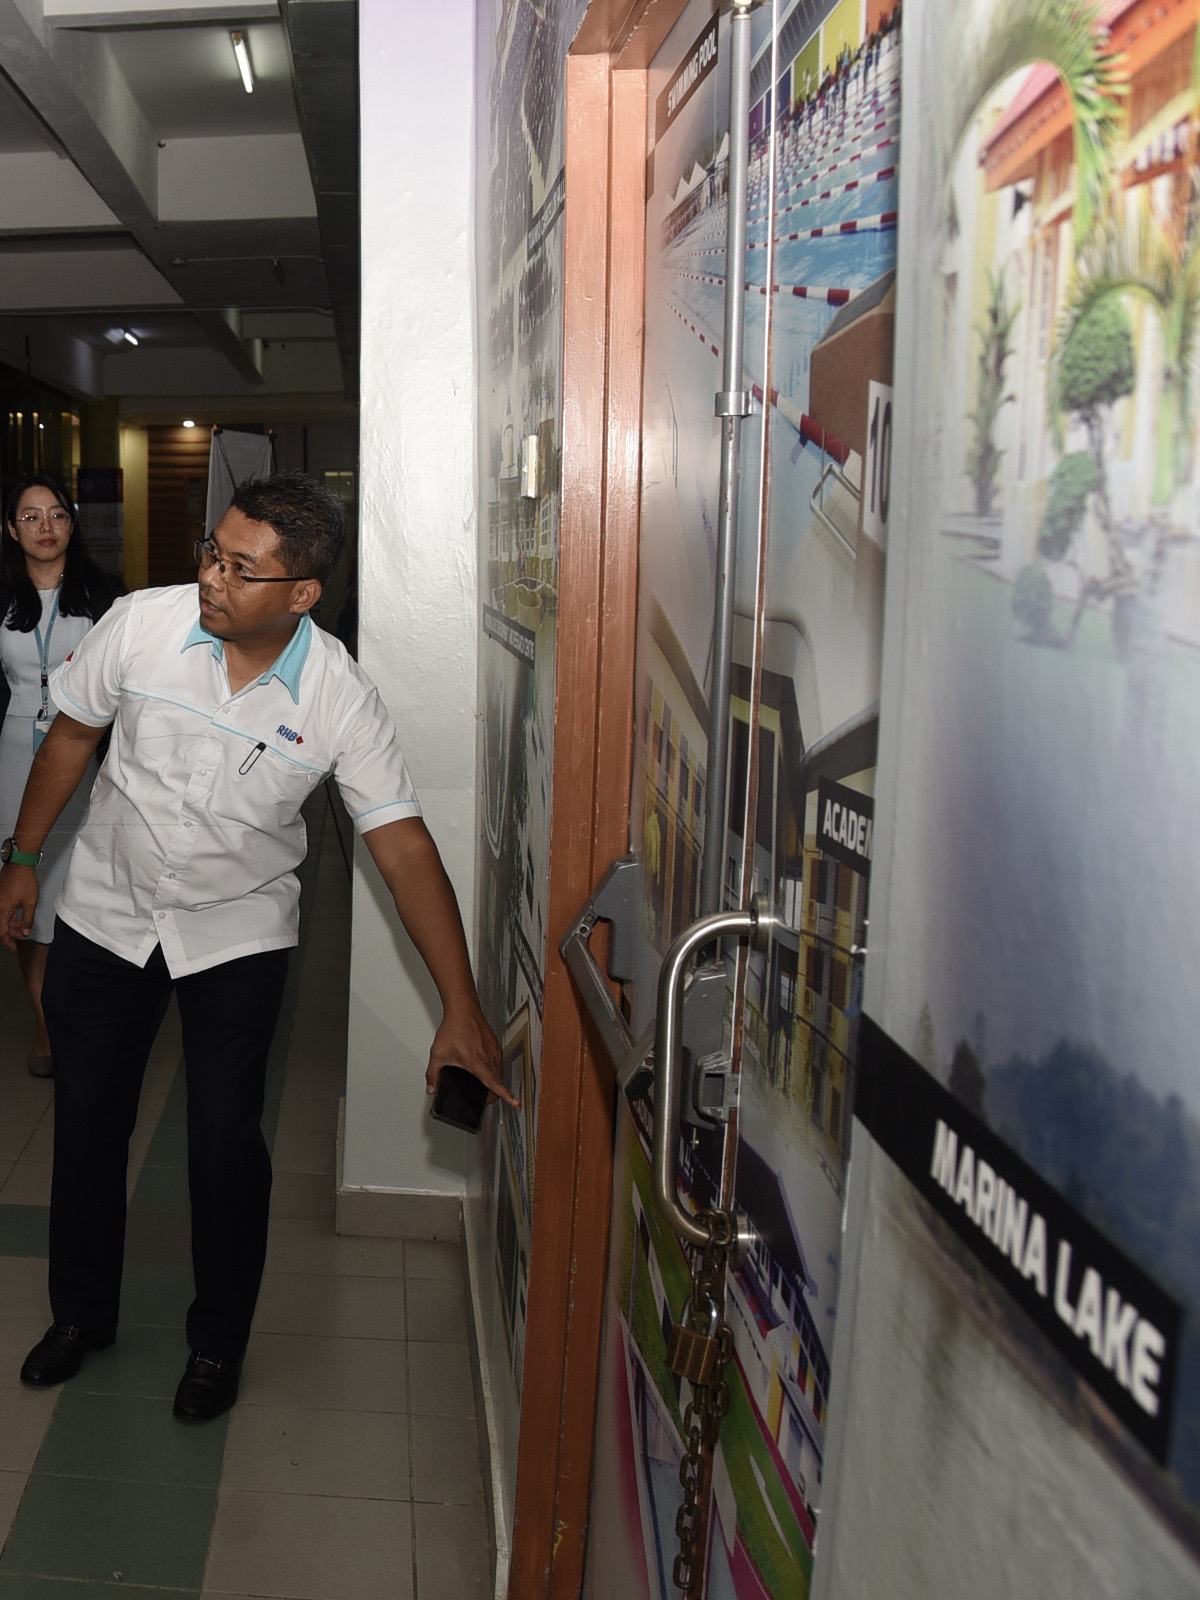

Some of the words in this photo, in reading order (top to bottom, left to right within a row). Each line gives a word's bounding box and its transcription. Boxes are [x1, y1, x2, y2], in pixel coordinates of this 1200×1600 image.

[667, 51, 699, 117] SWIMMING
[698, 27, 717, 74] POOL
[870, 396, 892, 525] 10
[275, 724, 299, 742] RHB
[930, 1117, 1048, 1298] MARINA
[1054, 1238, 1167, 1418] LAKE
